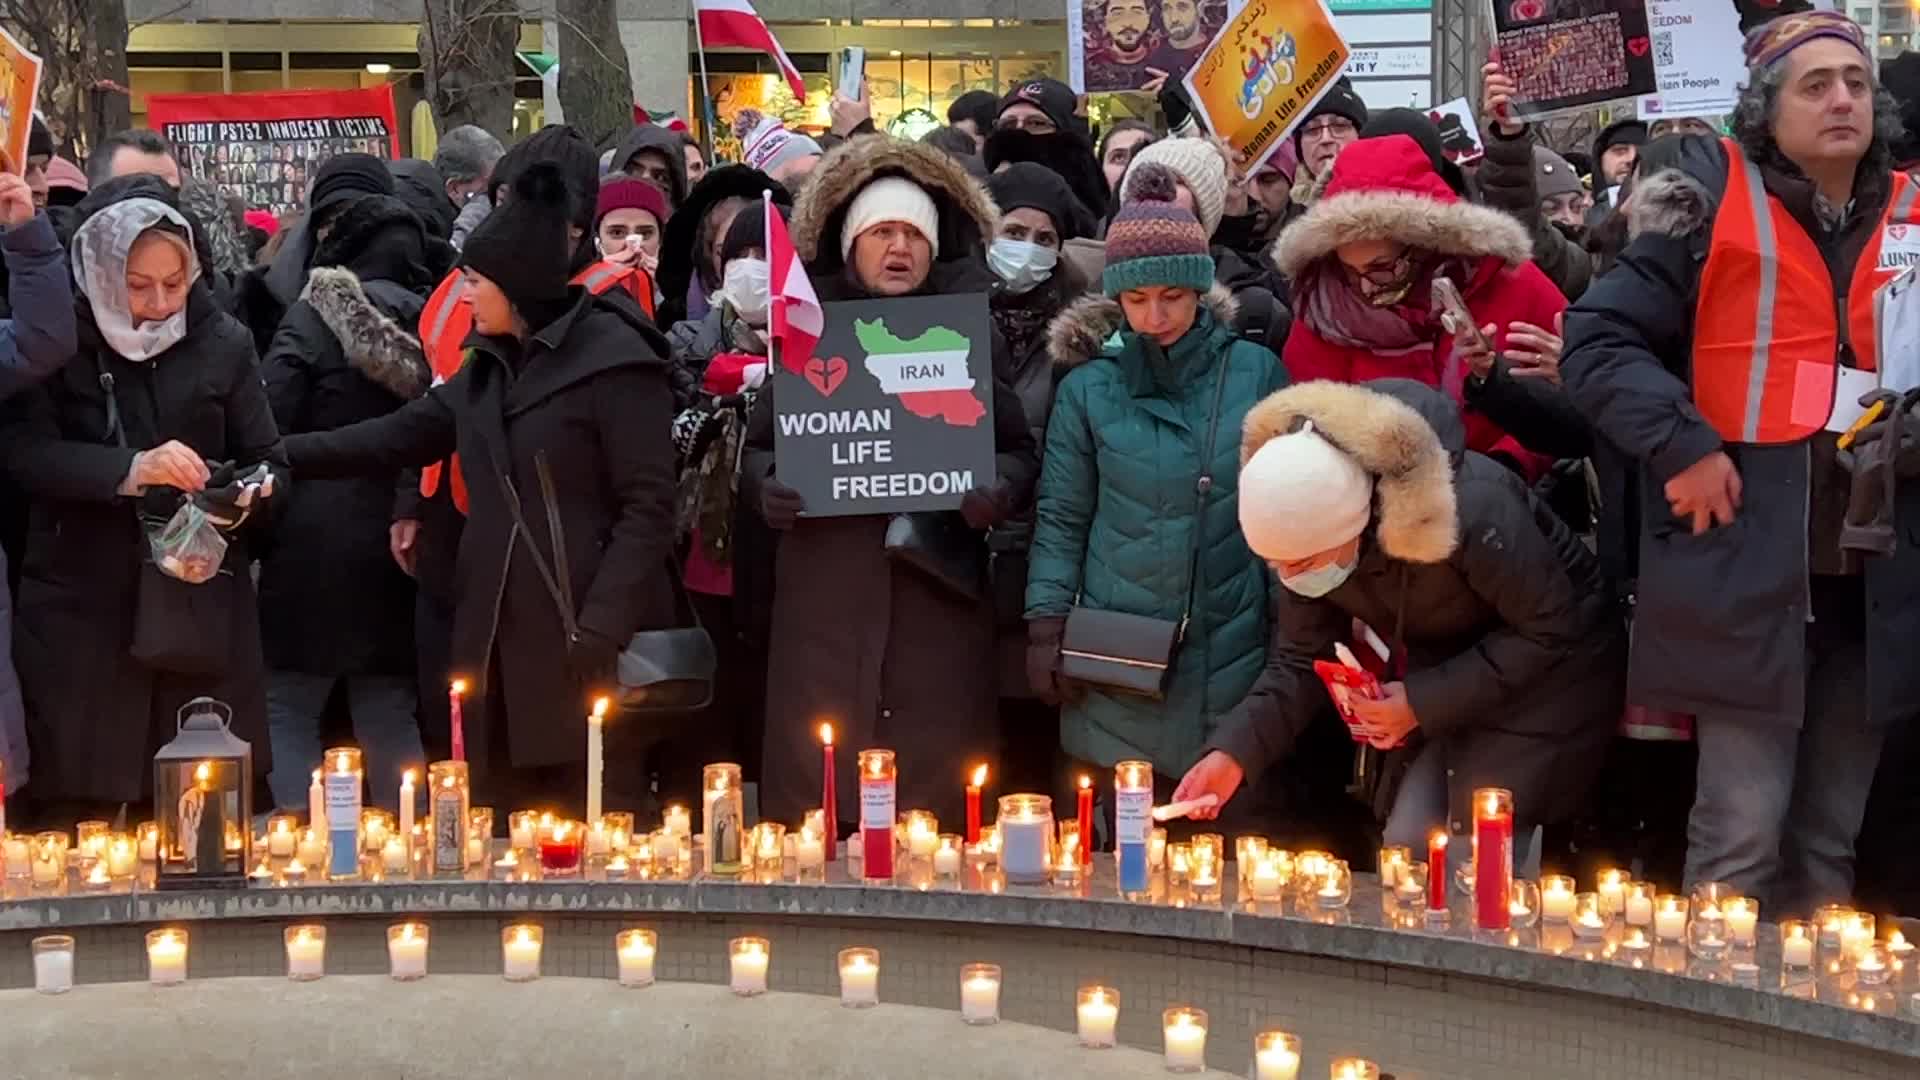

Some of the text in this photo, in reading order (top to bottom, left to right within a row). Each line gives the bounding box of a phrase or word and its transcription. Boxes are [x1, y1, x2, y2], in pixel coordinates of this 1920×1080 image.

[1682, 76, 1720, 90] People
[167, 117, 386, 142] FLIGHT PS752 INNOCENT VICTIMS
[900, 363, 945, 381] IRAN
[778, 408, 892, 436] WOMAN
[831, 439, 893, 465] LIFE
[831, 469, 974, 500] FREEDOM
